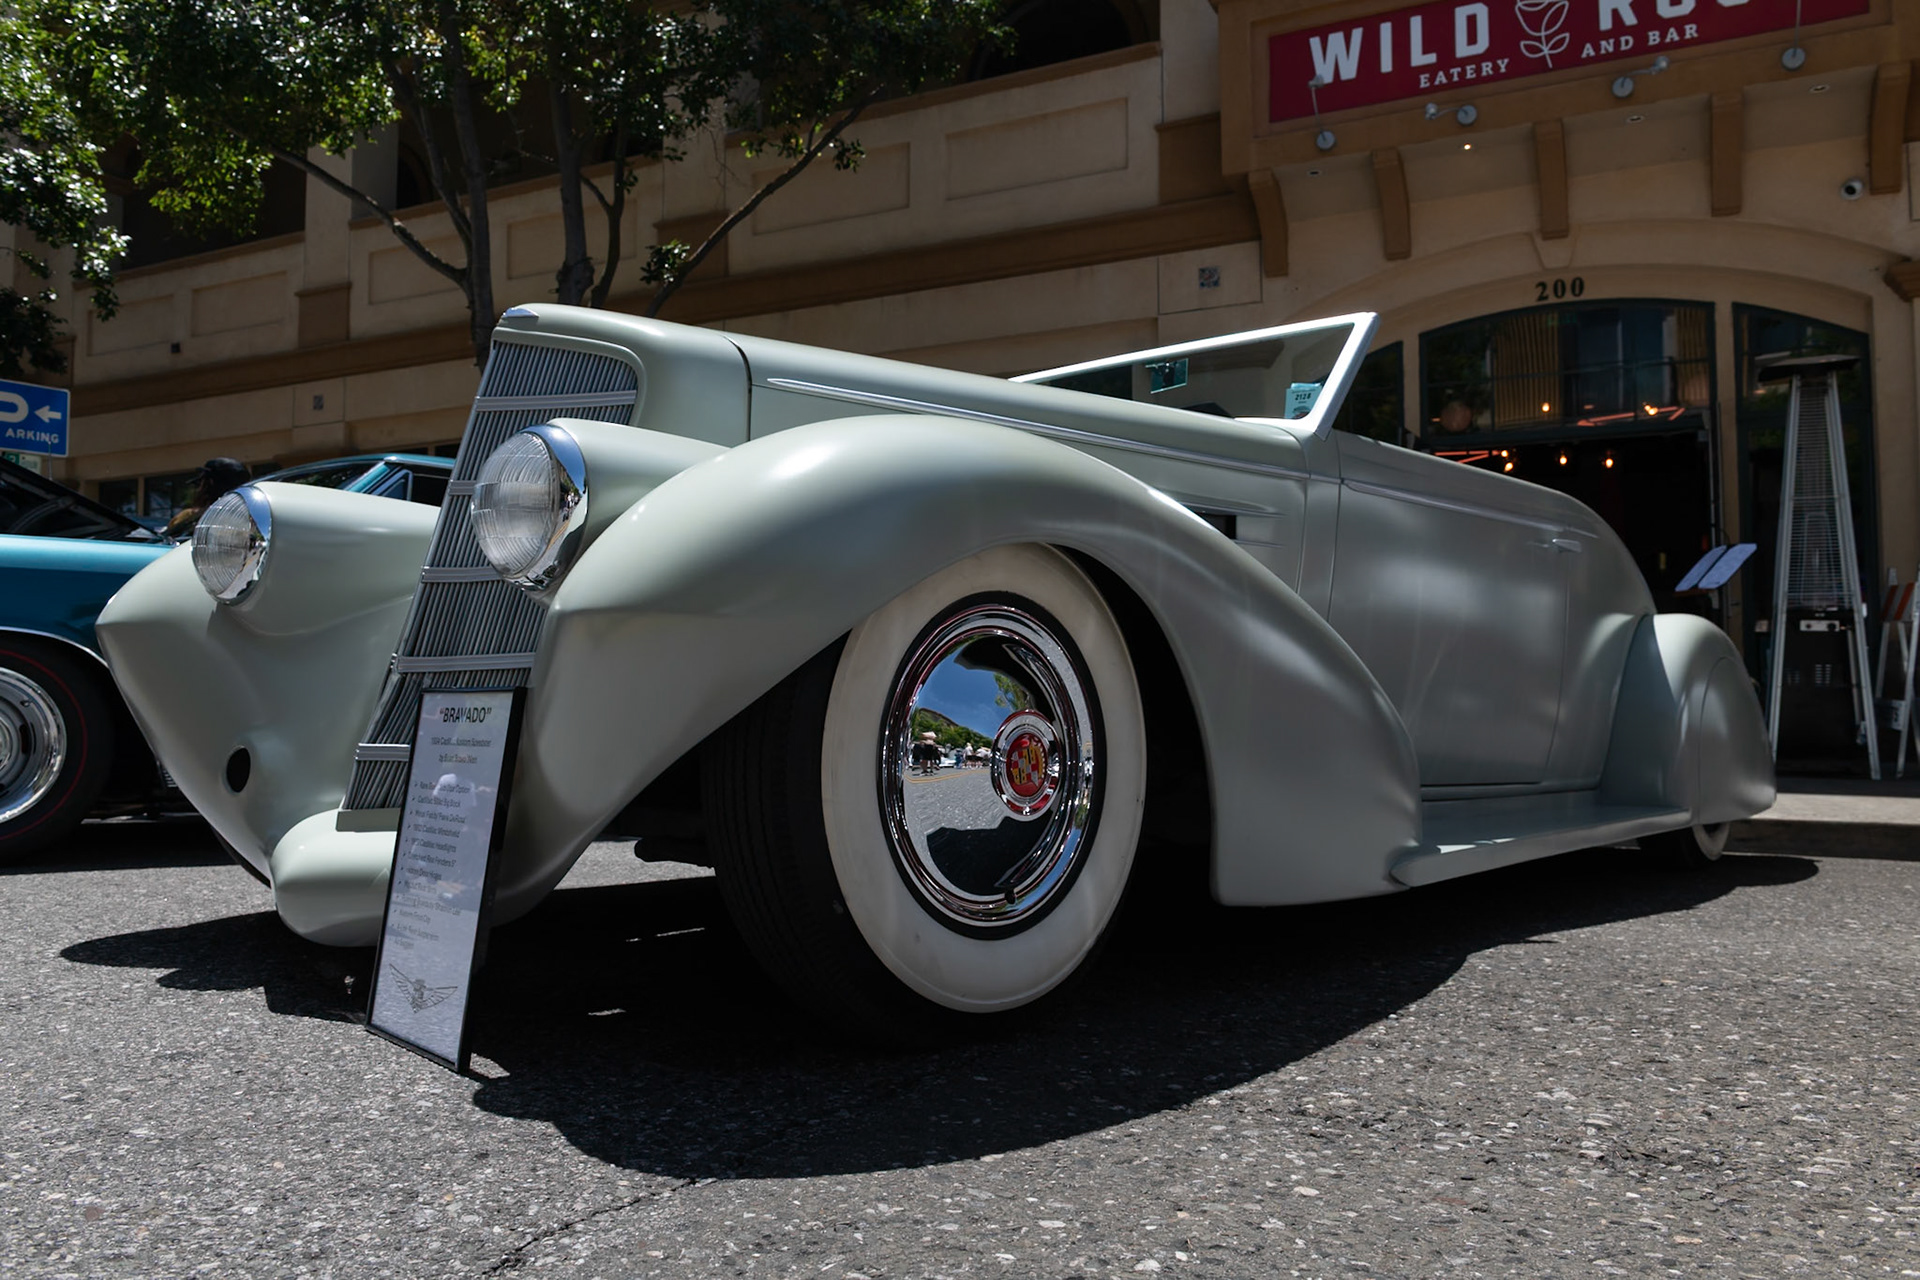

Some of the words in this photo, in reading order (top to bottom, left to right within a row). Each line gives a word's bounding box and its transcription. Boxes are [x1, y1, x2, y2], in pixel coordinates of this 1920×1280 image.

[1309, 2, 1489, 84] WILD
[1419, 58, 1510, 89] EATERY
[1581, 35, 1634, 58] AND
[1647, 23, 1699, 46] BAR
[1535, 276, 1585, 302] 200
